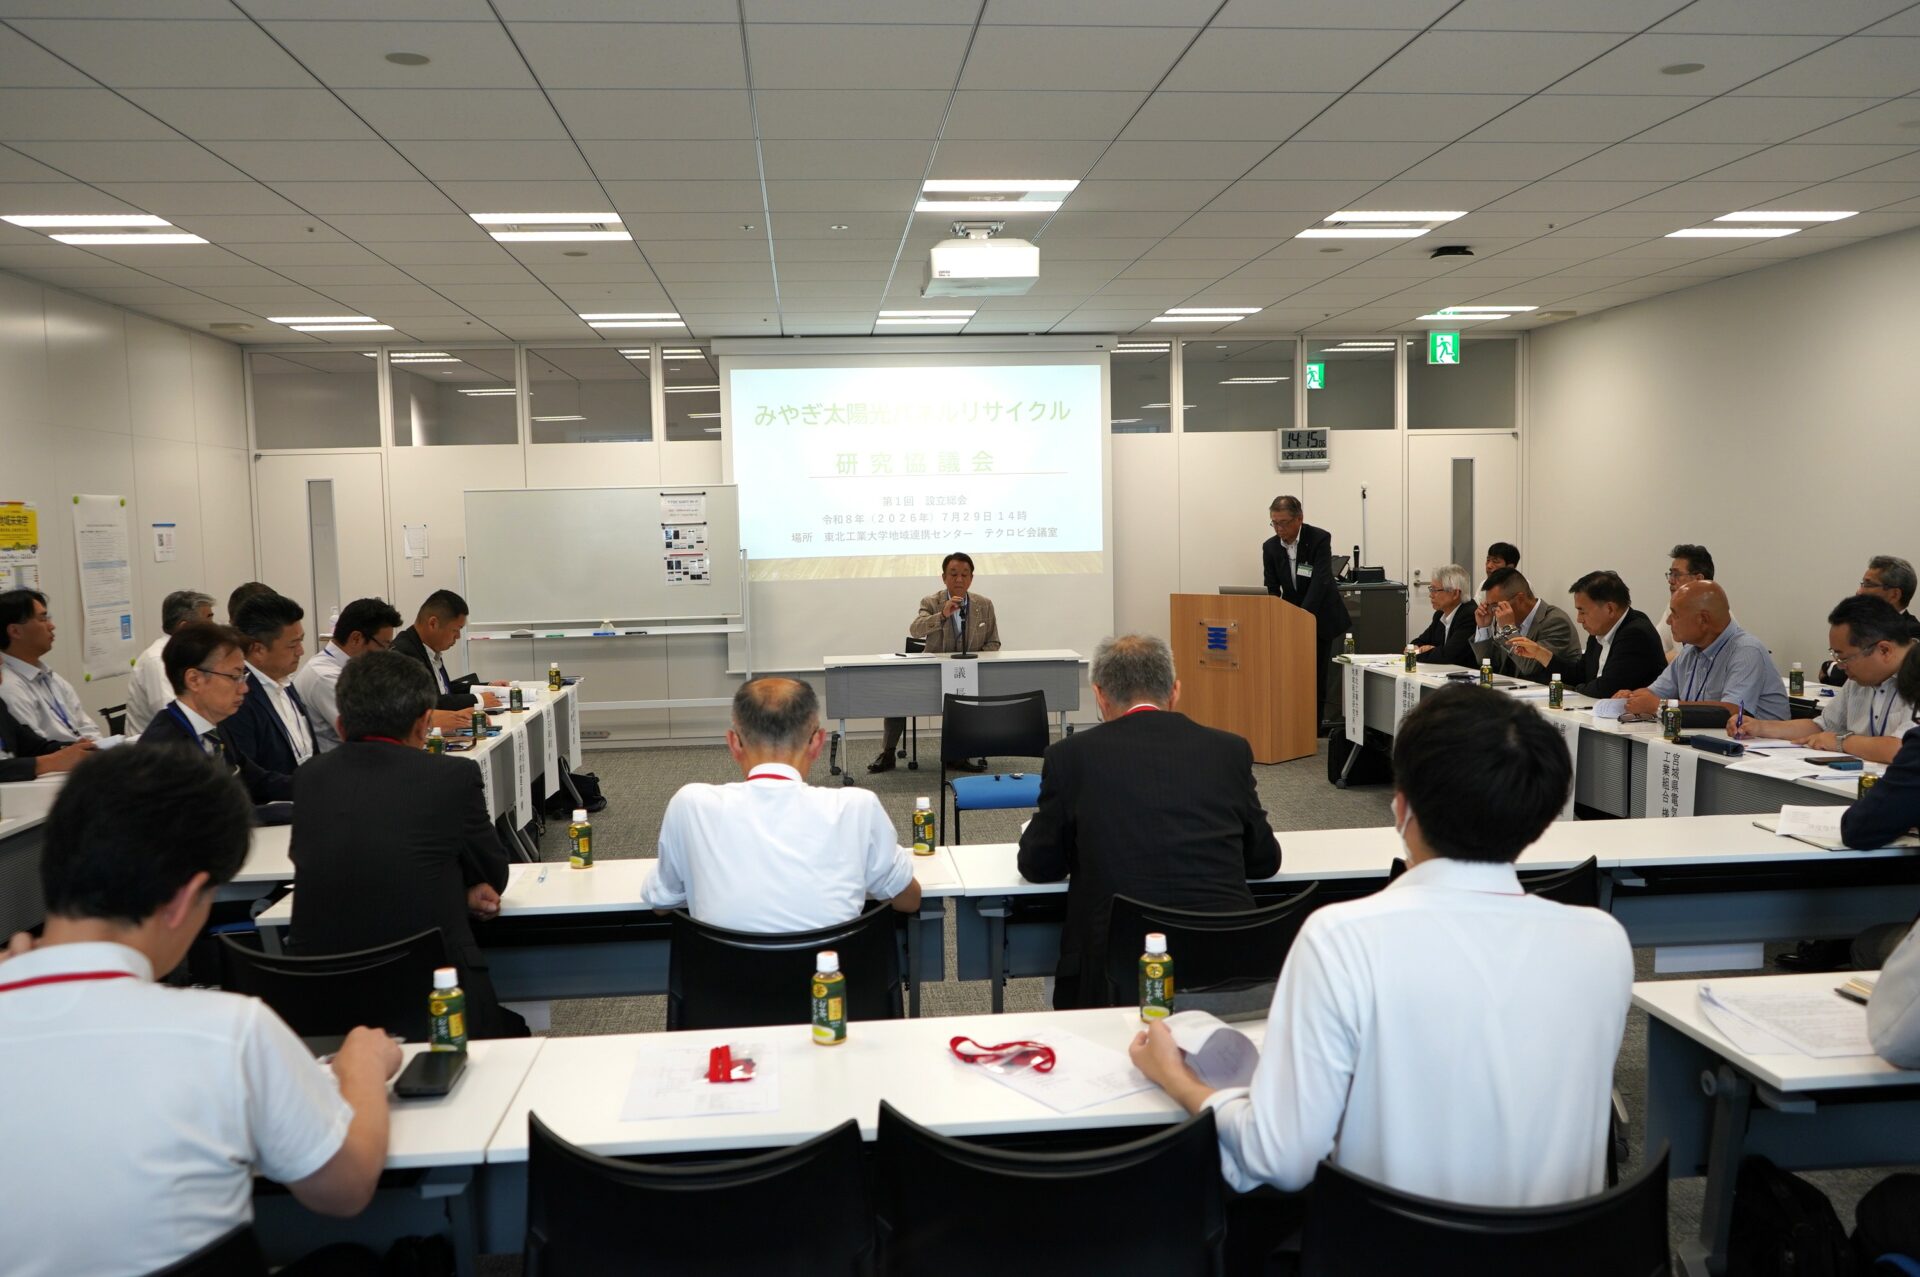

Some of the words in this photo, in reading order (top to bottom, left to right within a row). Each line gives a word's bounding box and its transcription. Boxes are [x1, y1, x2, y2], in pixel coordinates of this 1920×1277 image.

[1288, 431, 1318, 448] 14:15
[836, 450, 994, 475] 研究協議会
[791, 532, 813, 543] 場所
[824, 528, 974, 543] 東北工業大学地域連携センター
